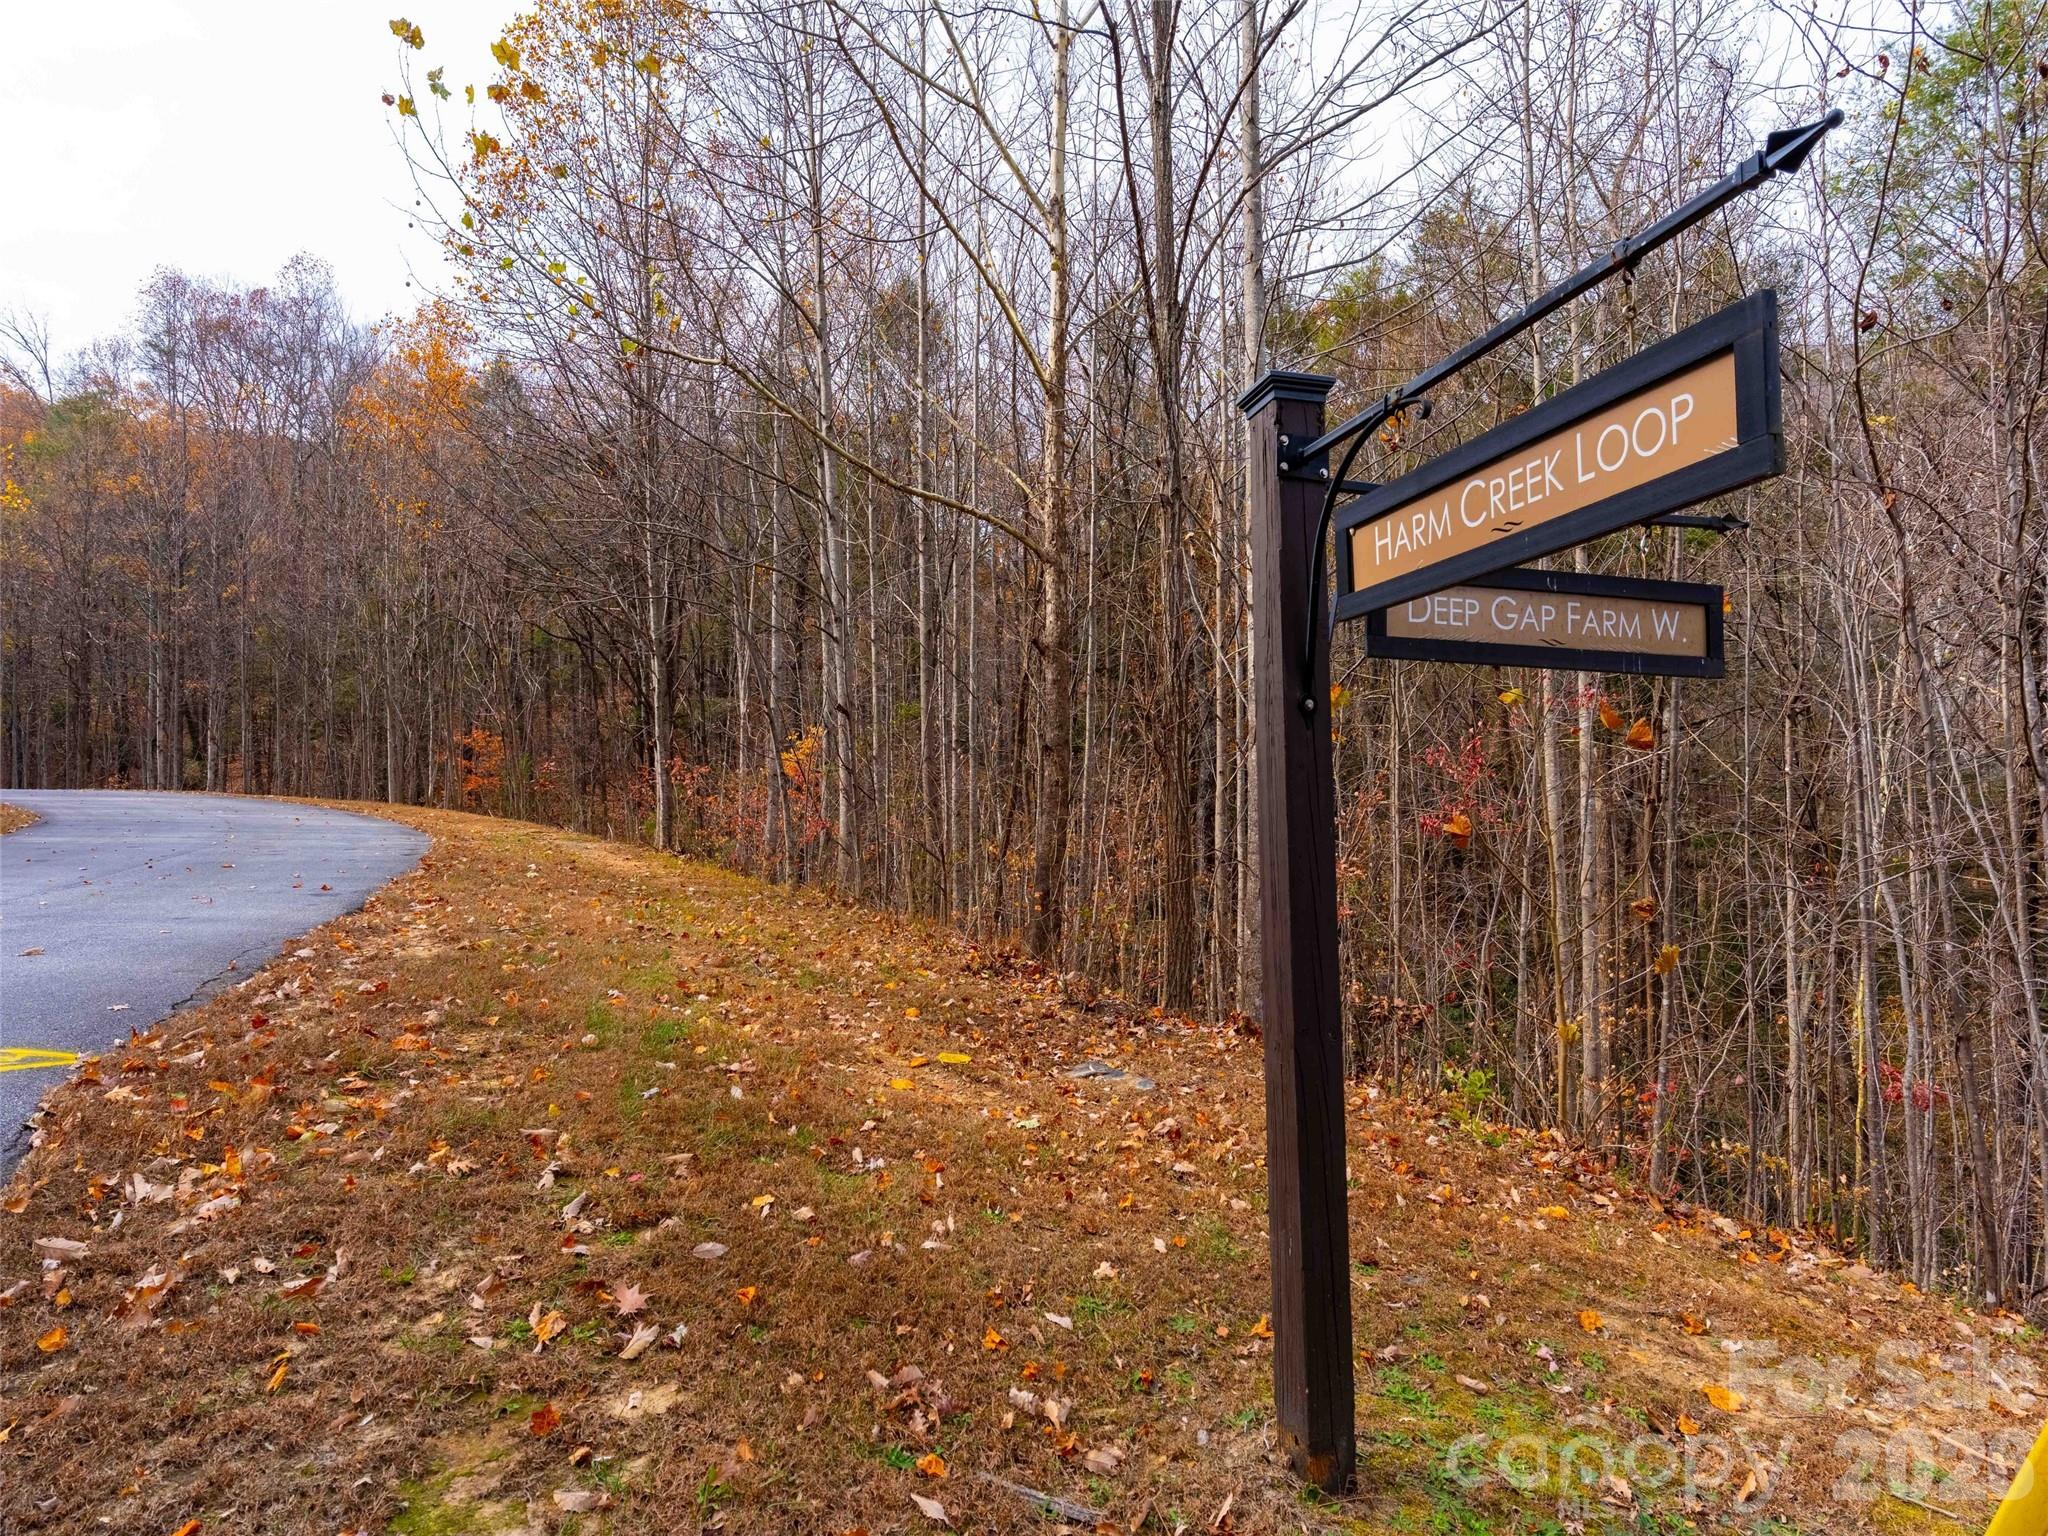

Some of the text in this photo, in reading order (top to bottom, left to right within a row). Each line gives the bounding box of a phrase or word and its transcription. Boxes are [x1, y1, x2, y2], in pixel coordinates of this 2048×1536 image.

[1374, 392, 1695, 566] HARM CREEK LOOP
[1408, 596, 1688, 644] DEEP GAP FARM W.
